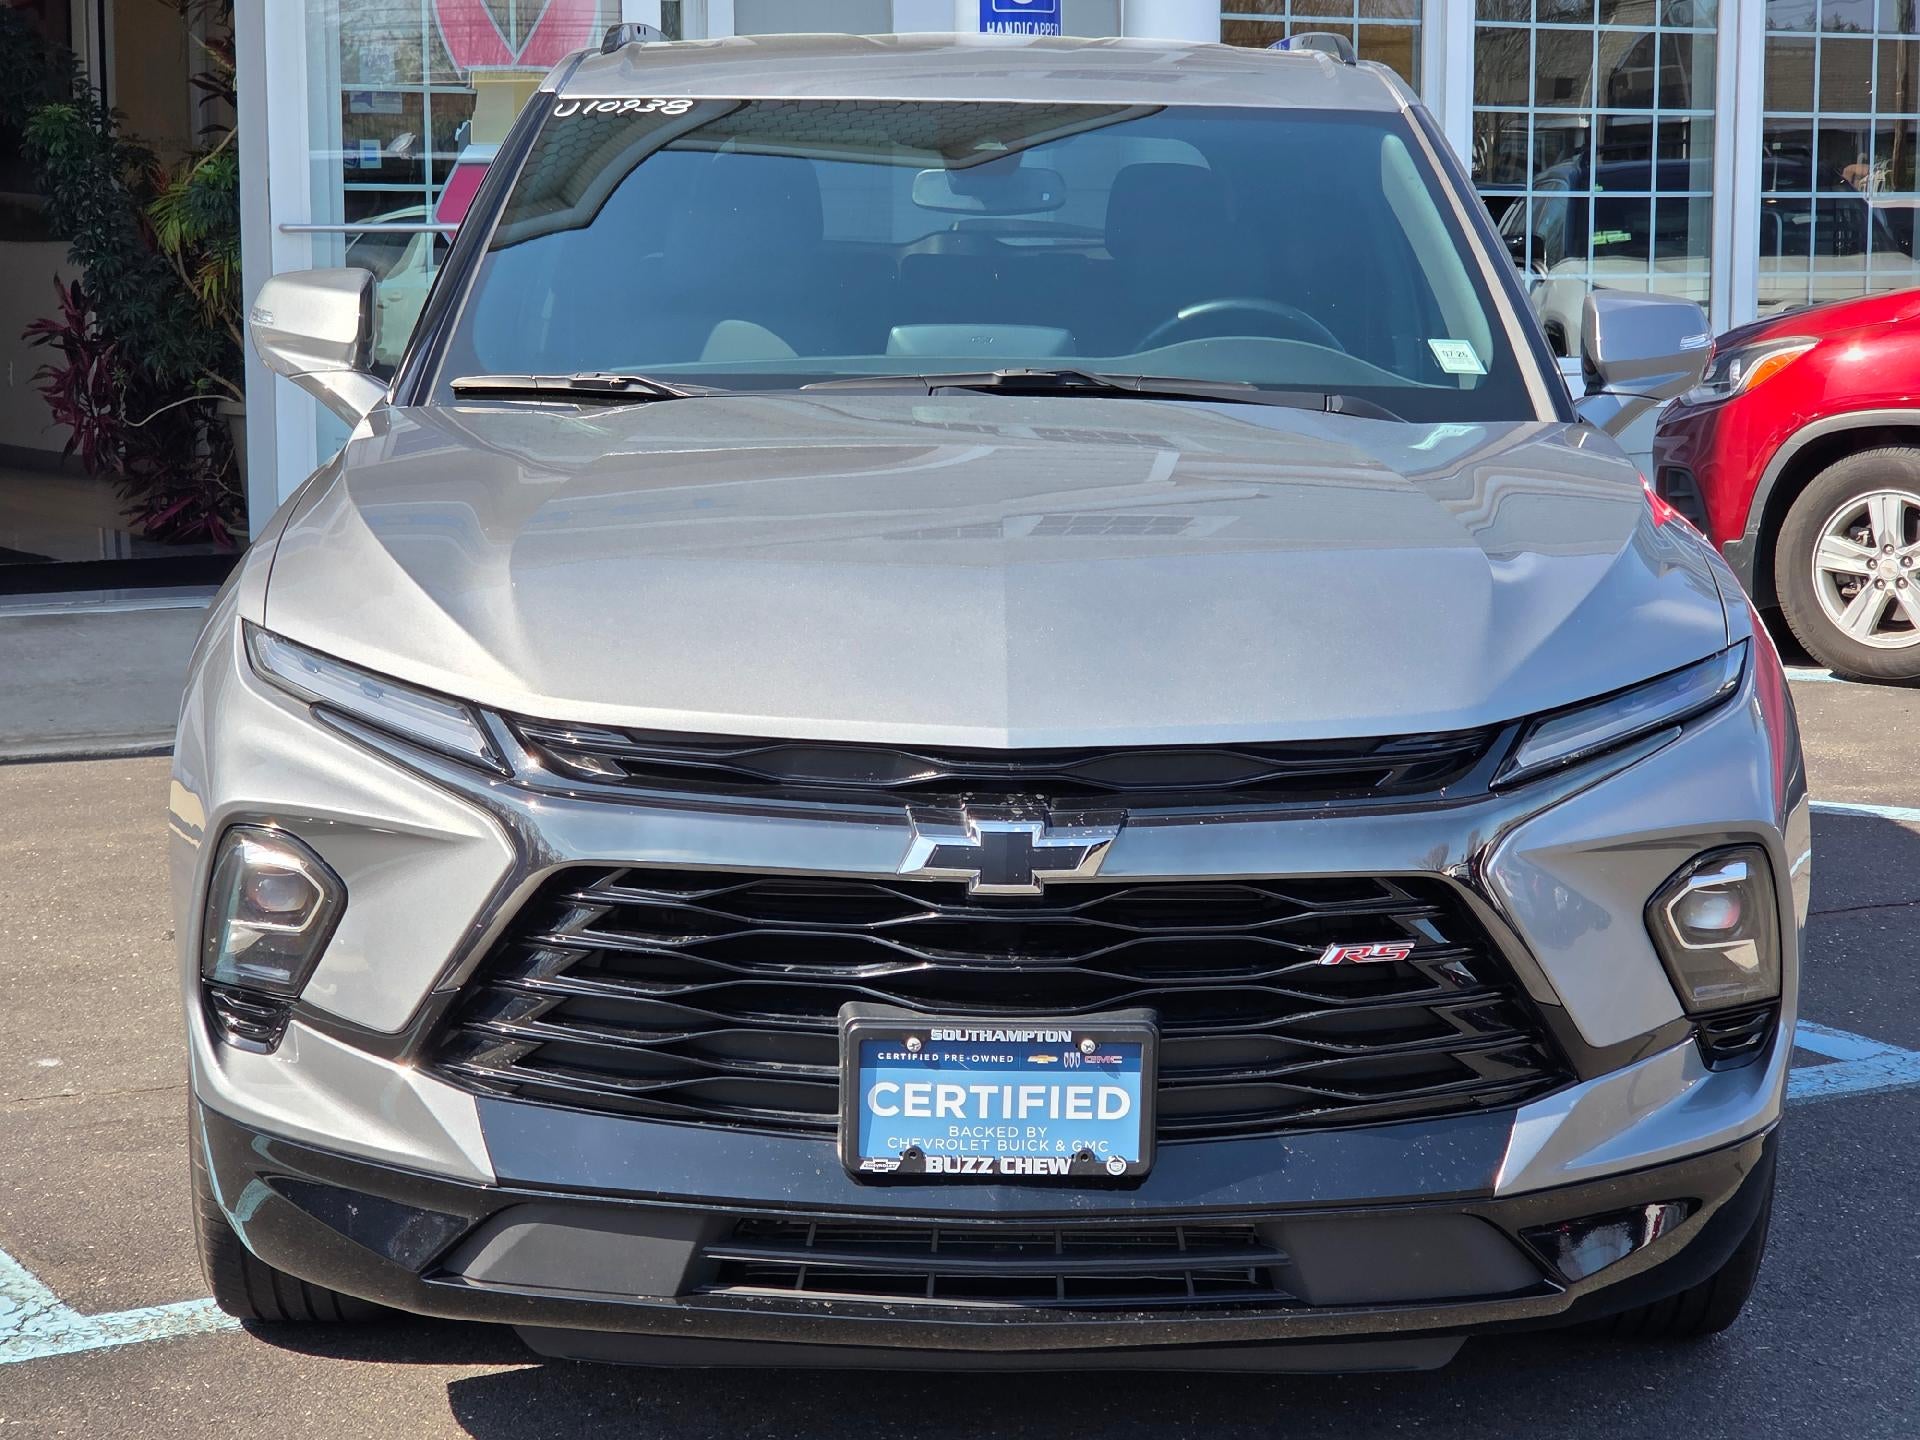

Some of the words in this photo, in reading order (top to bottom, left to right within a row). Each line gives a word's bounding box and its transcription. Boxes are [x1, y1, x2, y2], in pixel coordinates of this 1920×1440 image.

[986, 21, 1059, 37] HANDICAPPED
[553, 99, 694, 117] U10938
[1319, 943, 1416, 965] RS
[930, 1028, 1072, 1043] SOUTHAMPTON
[877, 1052, 939, 1061] CERTIFIED
[944, 1054, 1014, 1063] PRE-OWNED
[1084, 1055, 1122, 1064] GMC
[867, 1081, 1131, 1120] CERTIFIED
[949, 1125, 1019, 1138] BACKED
[1026, 1126, 1047, 1138] BY
[887, 1136, 990, 1151] CHEVROLET
[998, 1139, 1049, 1152] BUICK
[1055, 1140, 1066, 1152] &
[1072, 1140, 1109, 1153] GMC
[925, 1155, 993, 1174] BUZZ
[999, 1156, 1072, 1175] CHEW
